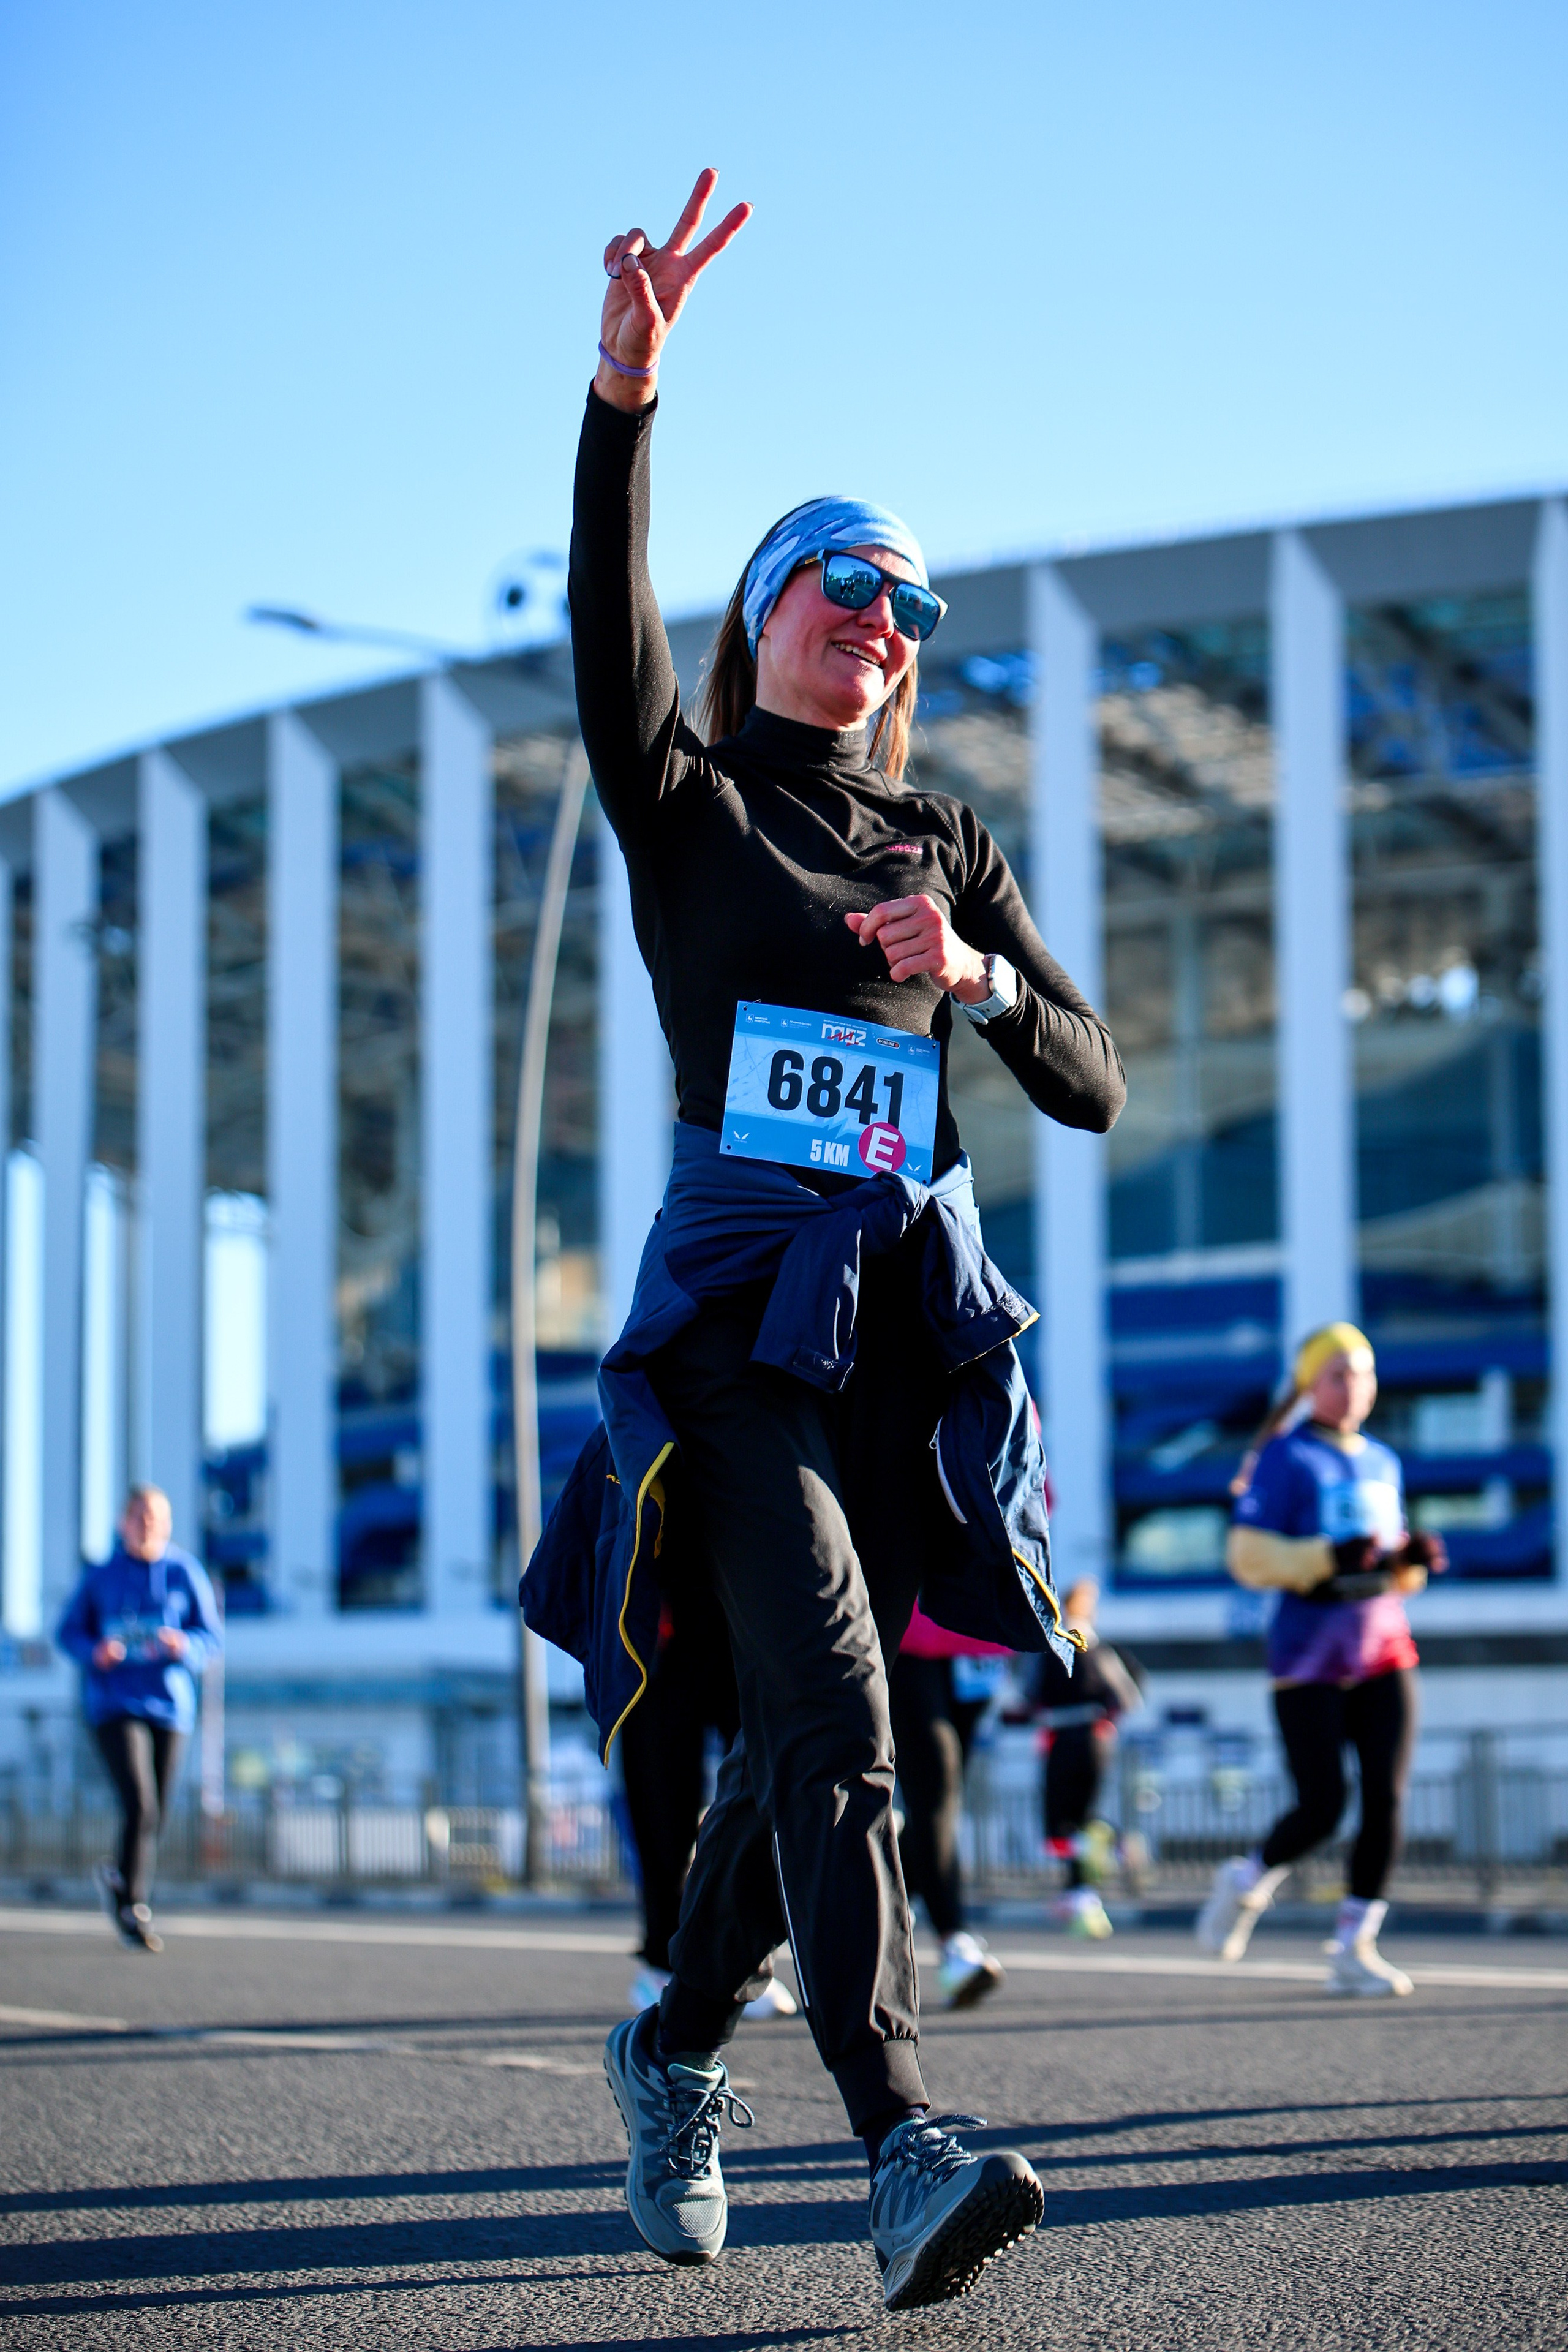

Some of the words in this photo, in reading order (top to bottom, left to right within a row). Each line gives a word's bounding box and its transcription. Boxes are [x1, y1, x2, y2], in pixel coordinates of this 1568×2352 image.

[767, 1049, 905, 1130] 6841
[810, 1139, 823, 1163] 5
[823, 1140, 850, 1167] KM
[865, 1126, 900, 1172] E
